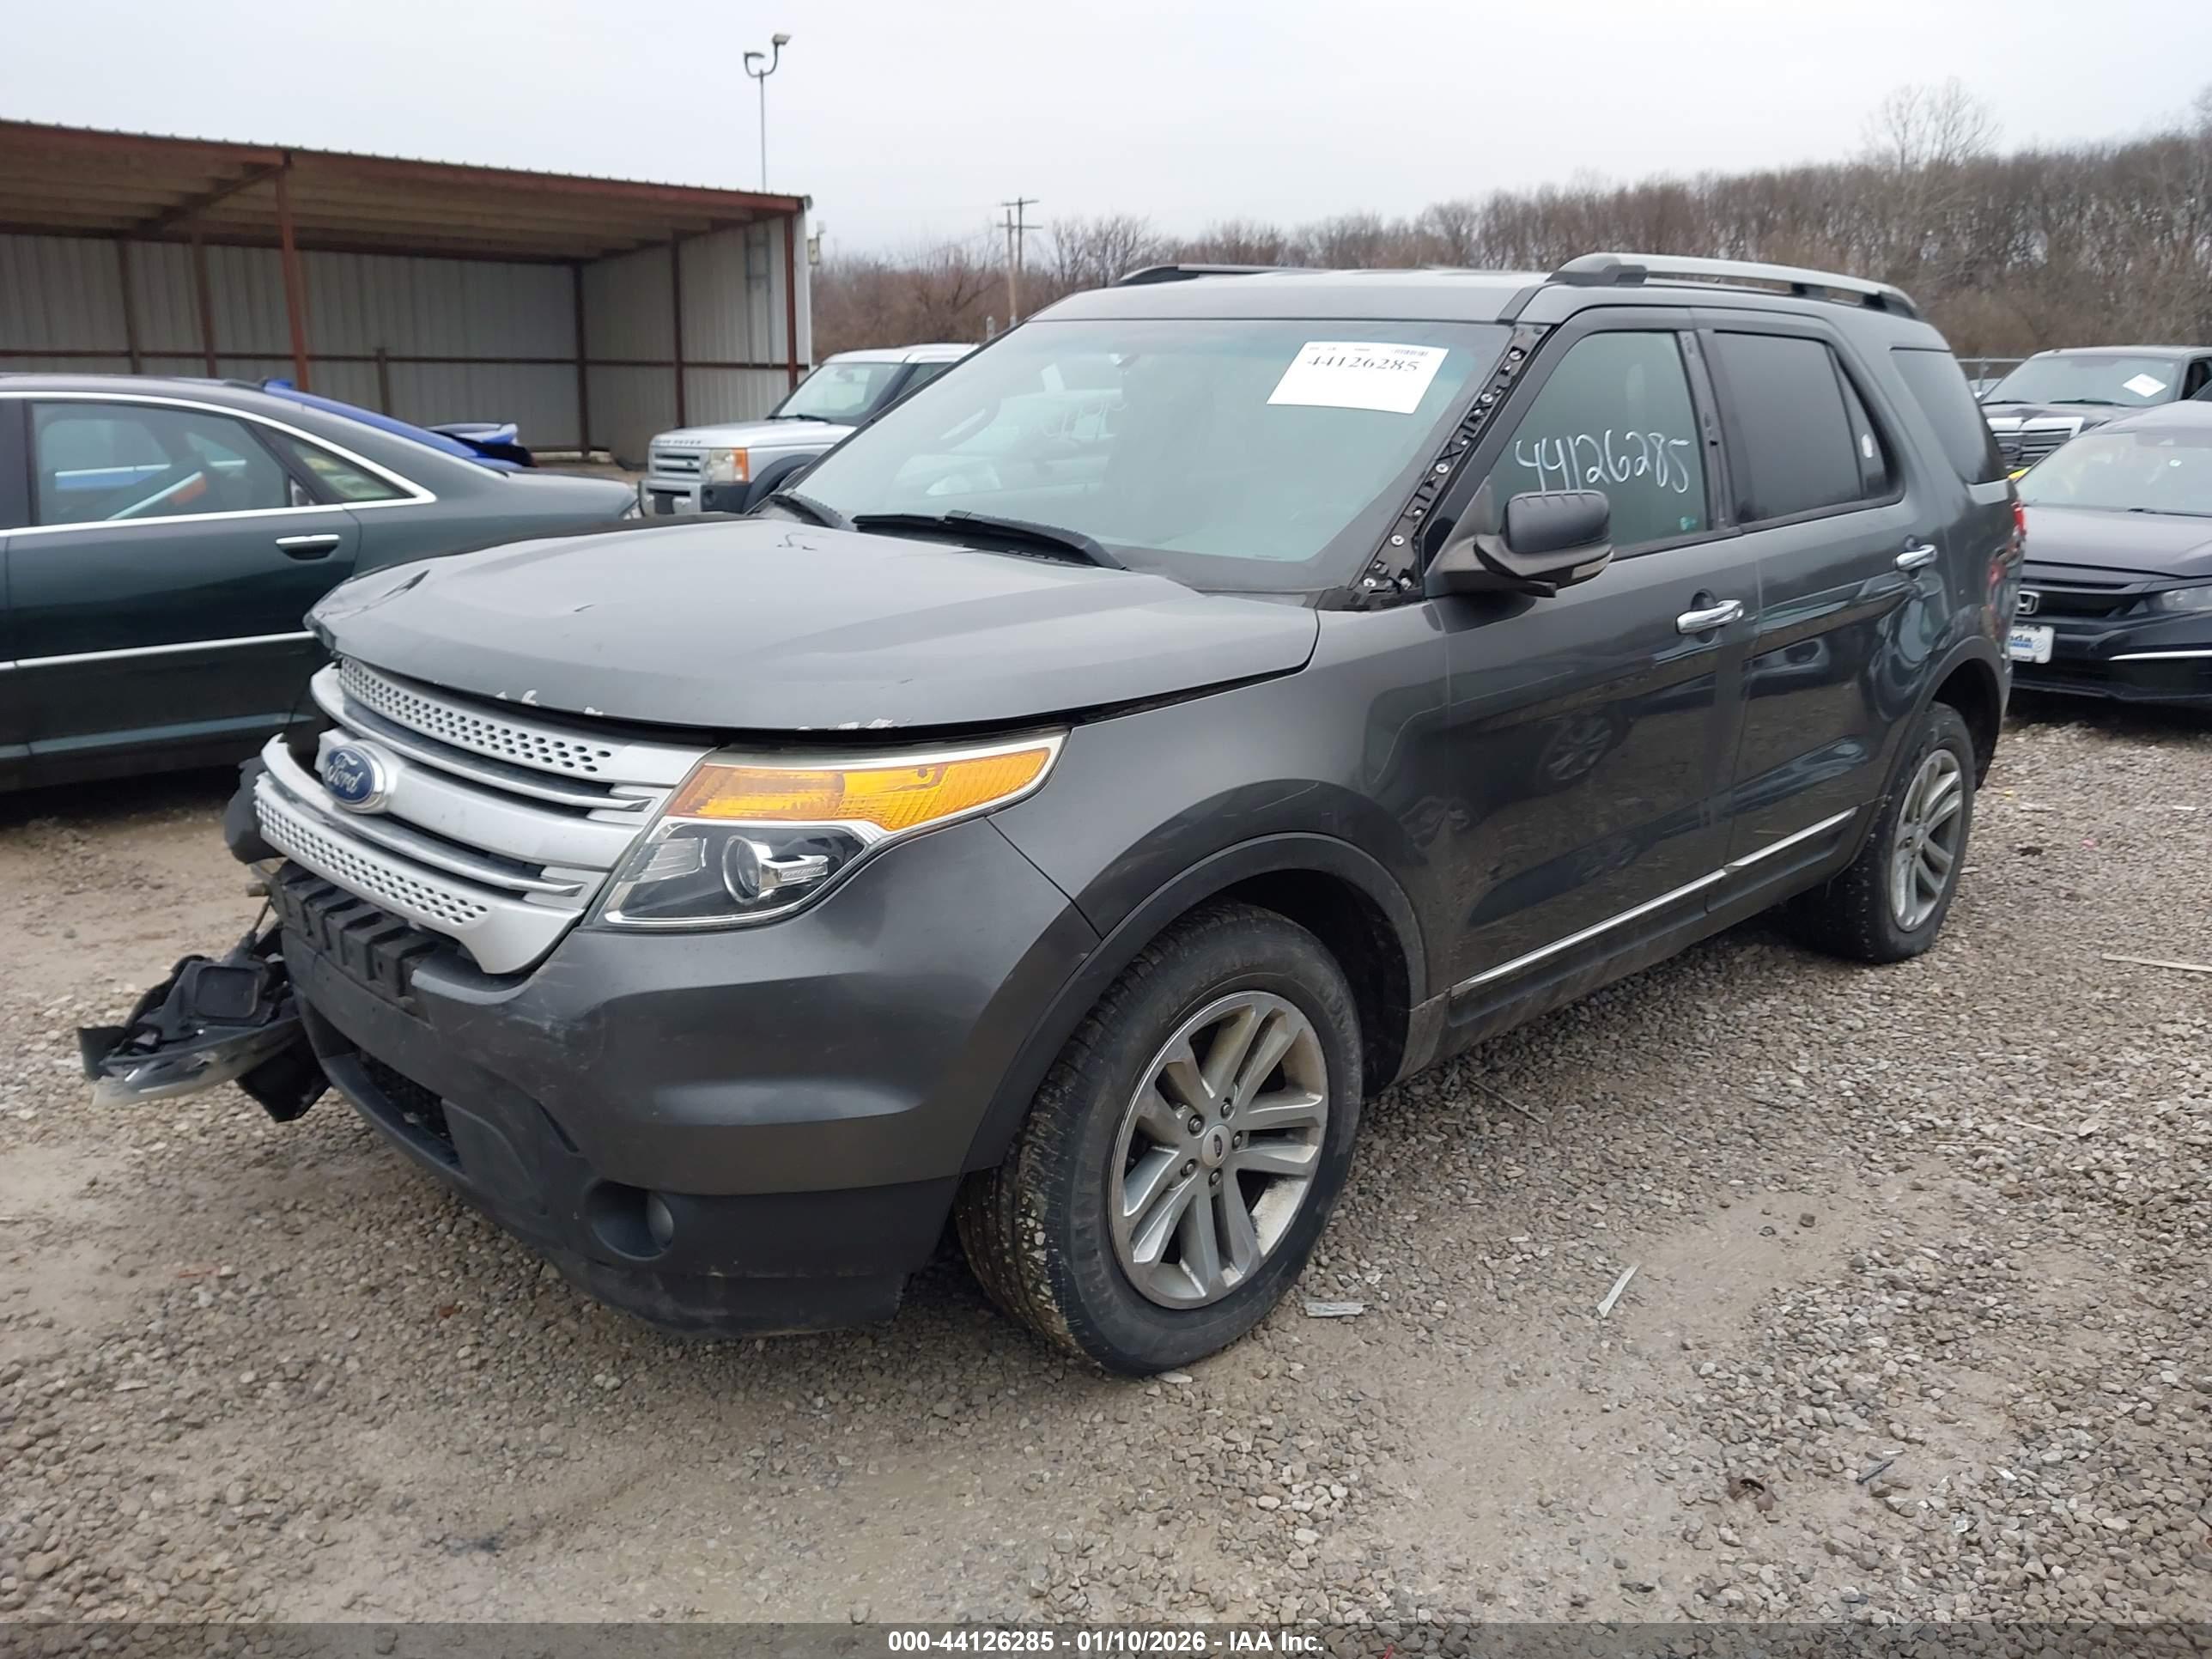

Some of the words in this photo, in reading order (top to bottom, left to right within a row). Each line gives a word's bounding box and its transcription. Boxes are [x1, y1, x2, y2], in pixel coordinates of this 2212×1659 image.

[1306, 356, 1420, 372] 44126285
[1515, 430, 1690, 494] 44126285
[327, 751, 364, 794] Ford
